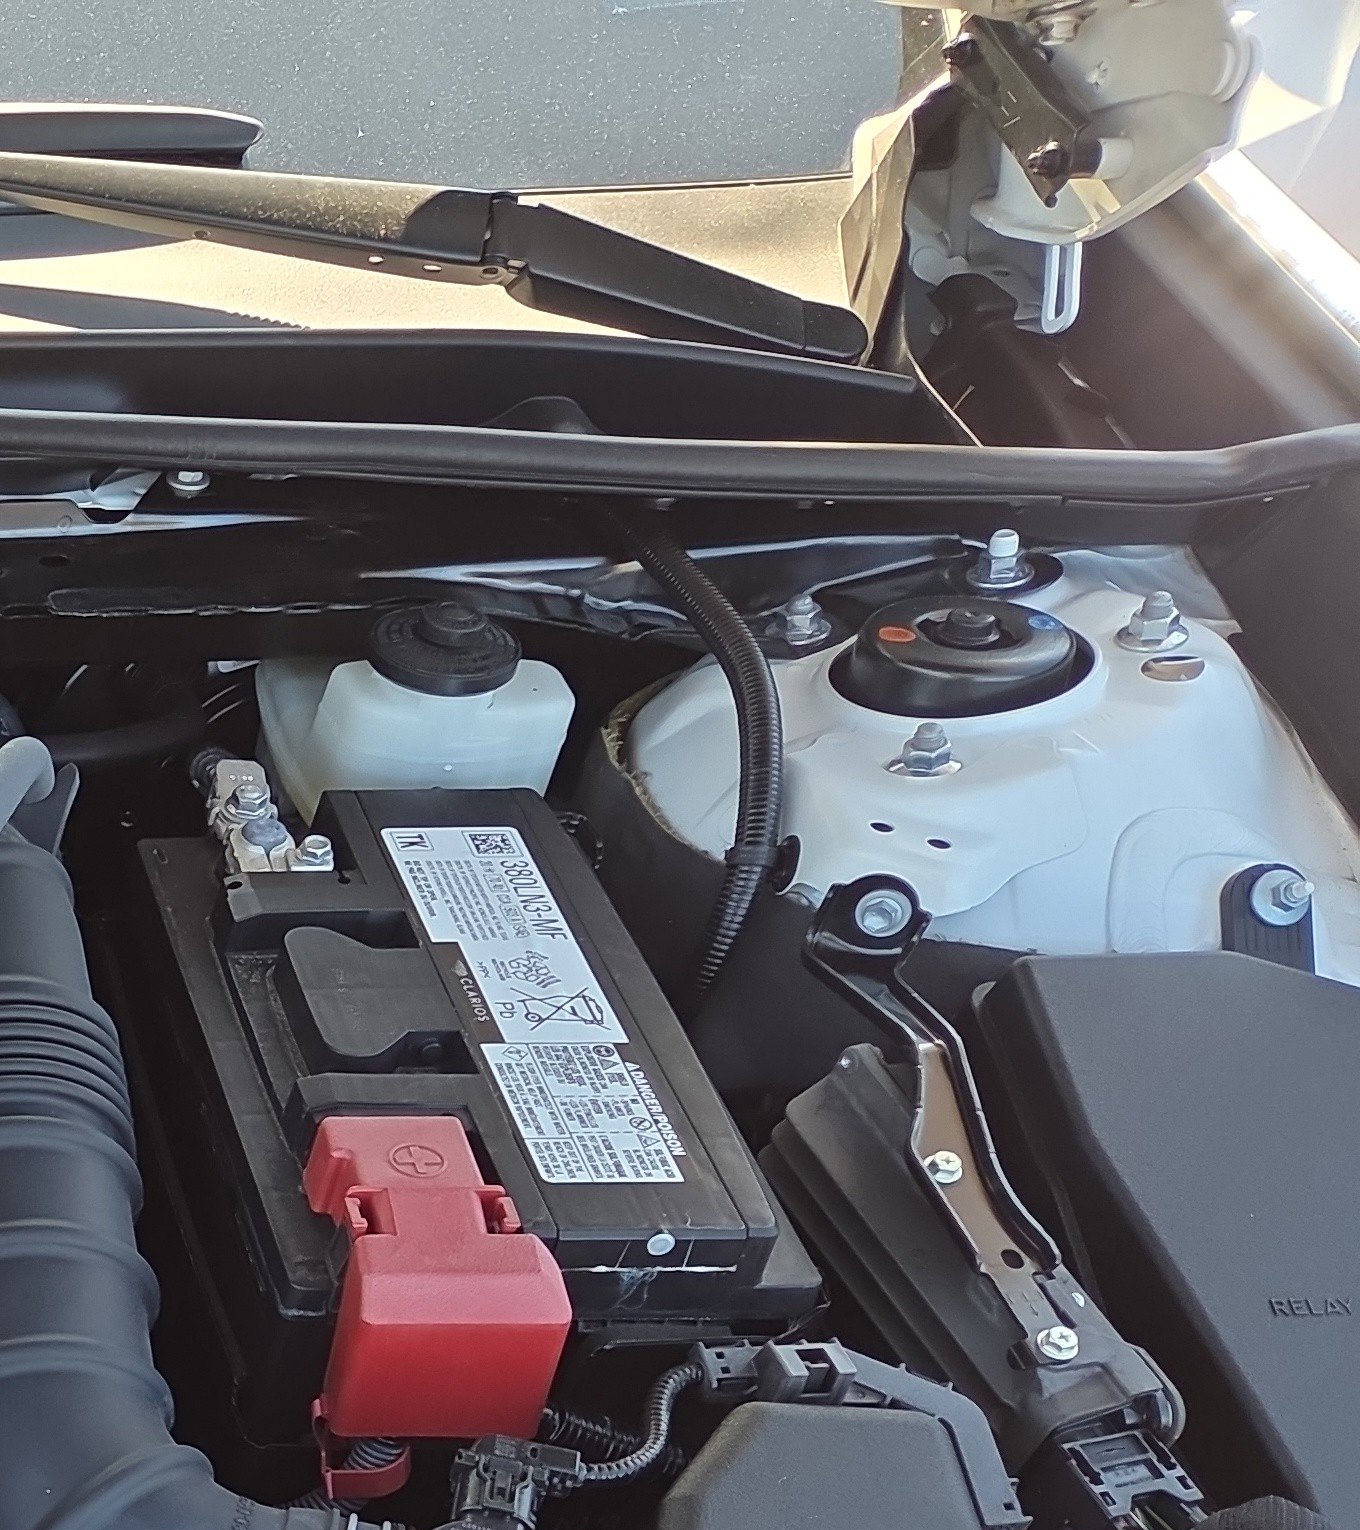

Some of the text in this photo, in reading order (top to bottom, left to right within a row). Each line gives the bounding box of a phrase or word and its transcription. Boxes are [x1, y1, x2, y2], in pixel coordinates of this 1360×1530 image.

[396, 834, 429, 849] TK
[500, 860, 569, 941] 380LN3-MF
[460, 977, 490, 1022] CLARIOS
[495, 1002, 517, 1018] Pb
[632, 1070, 687, 1156] DANGER/POISON
[1268, 1297, 1354, 1317] RELAY
